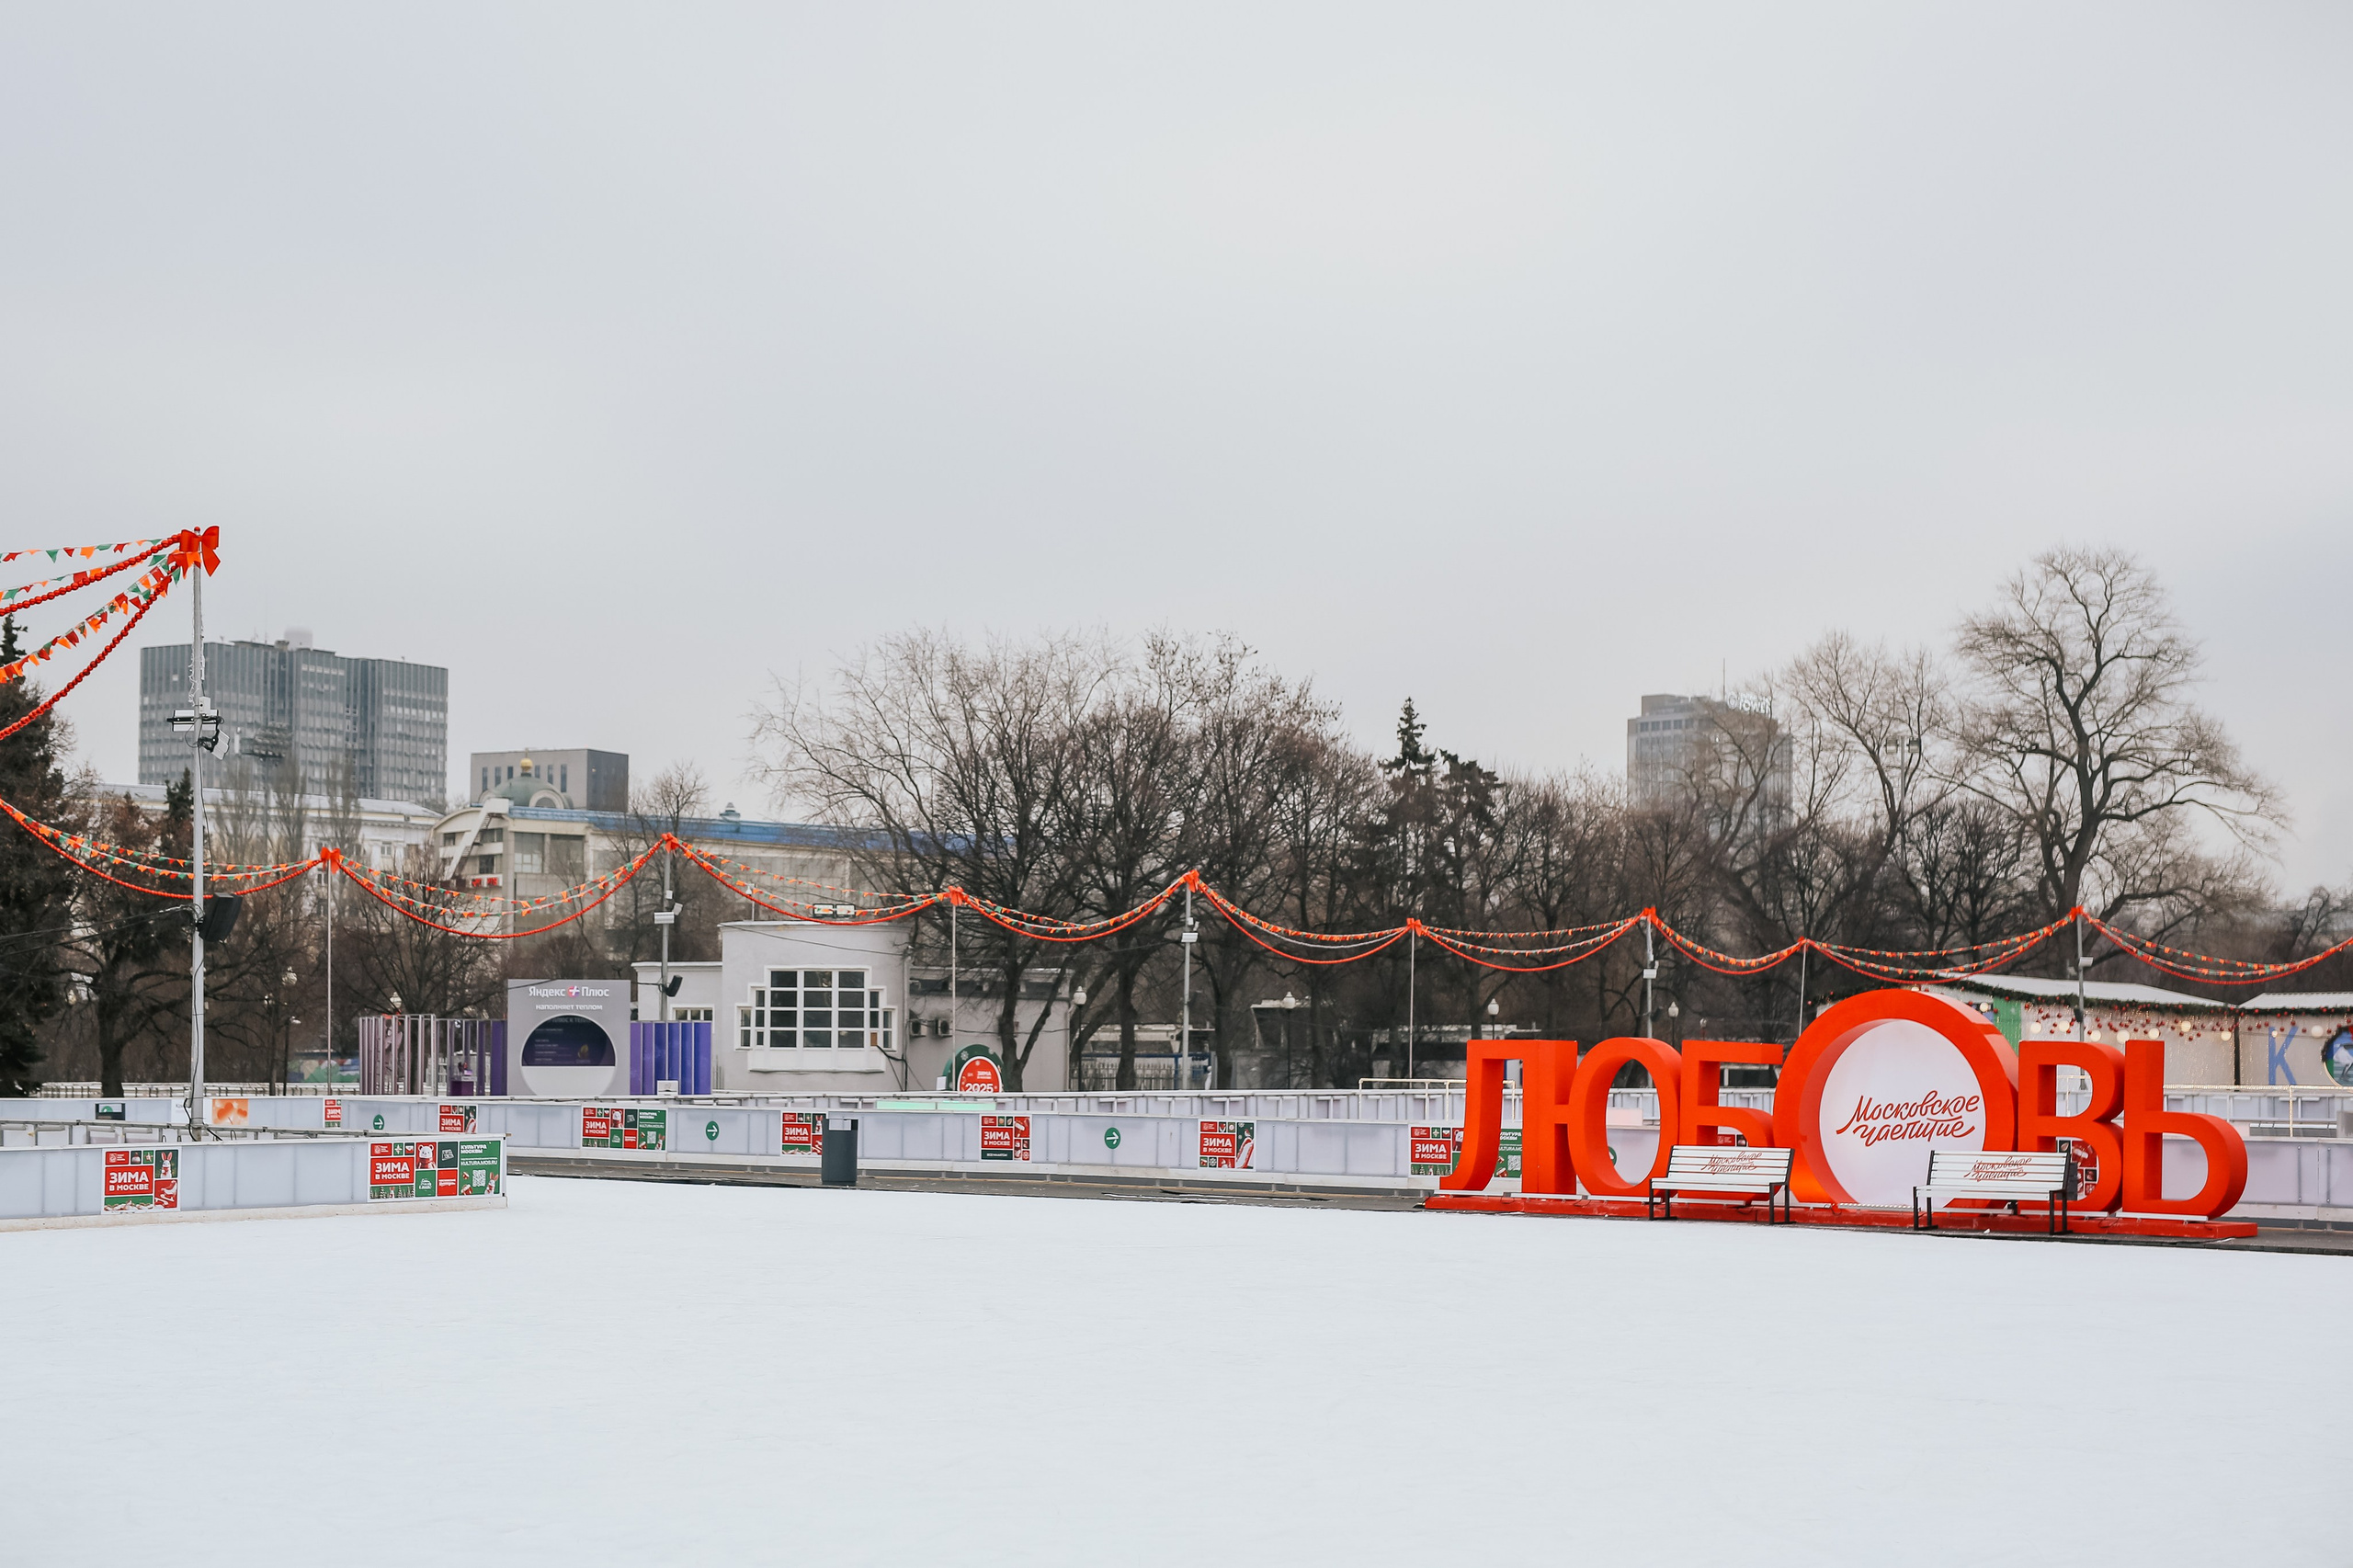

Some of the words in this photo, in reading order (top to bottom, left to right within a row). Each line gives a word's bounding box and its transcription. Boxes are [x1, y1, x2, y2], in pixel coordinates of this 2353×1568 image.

[529, 986, 566, 997] Яндекс
[581, 986, 609, 997] Плюс
[965, 1083, 995, 1092] 2025
[1439, 989, 2248, 1221] ЛЮБОВЬ
[1836, 1090, 1980, 1134] Московское
[983, 1131, 1011, 1140] ЗИМА
[1852, 1116, 1975, 1147] чаепитие
[1202, 1137, 1233, 1147] ЗИМА
[1415, 1143, 1447, 1153] ЗИМА
[375, 1162, 410, 1173] ЗИМА
[109, 1171, 149, 1184] ЗИМА
